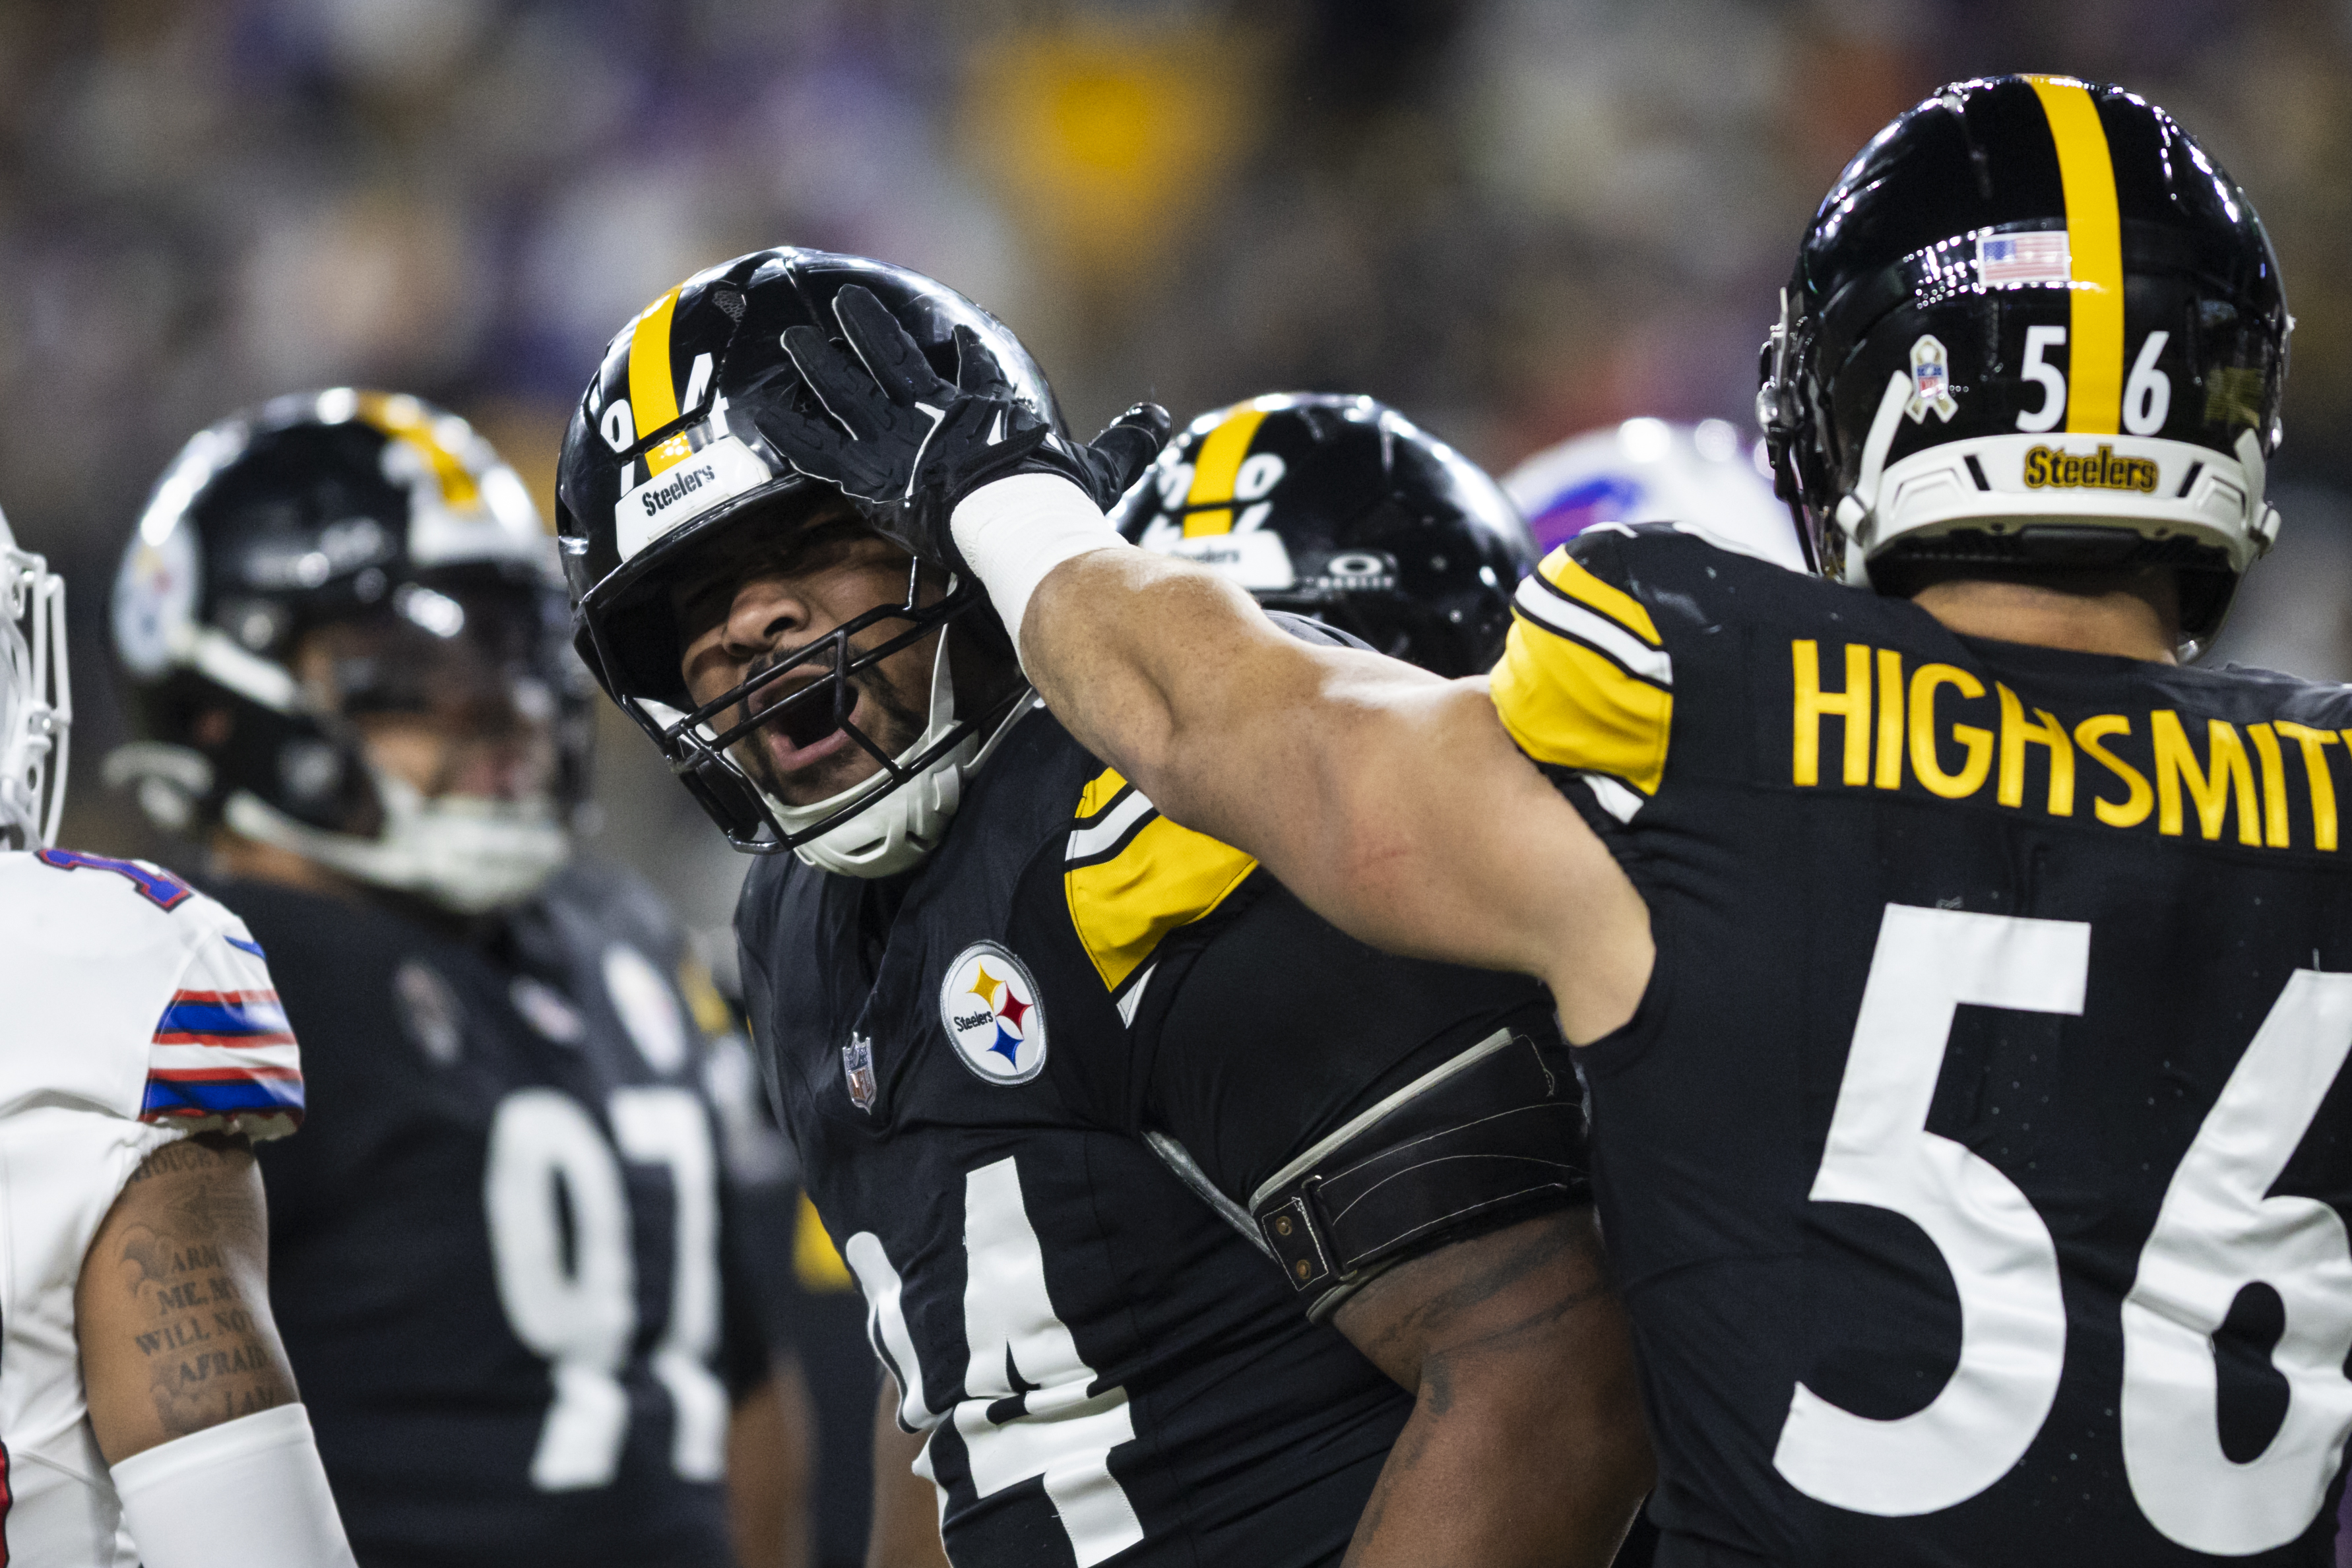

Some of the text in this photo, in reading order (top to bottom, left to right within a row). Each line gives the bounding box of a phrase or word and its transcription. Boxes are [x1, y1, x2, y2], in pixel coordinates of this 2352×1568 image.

[2016, 325, 2172, 436] 56
[642, 465, 715, 517] Steelers
[2025, 445, 2159, 493] Steelers
[1791, 639, 2352, 852] HIGHSMIT
[954, 1011, 994, 1032] Steelers
[1773, 902, 2352, 1556] 56
[483, 1085, 730, 1490] 97
[134, 1317, 211, 1357] WILL
